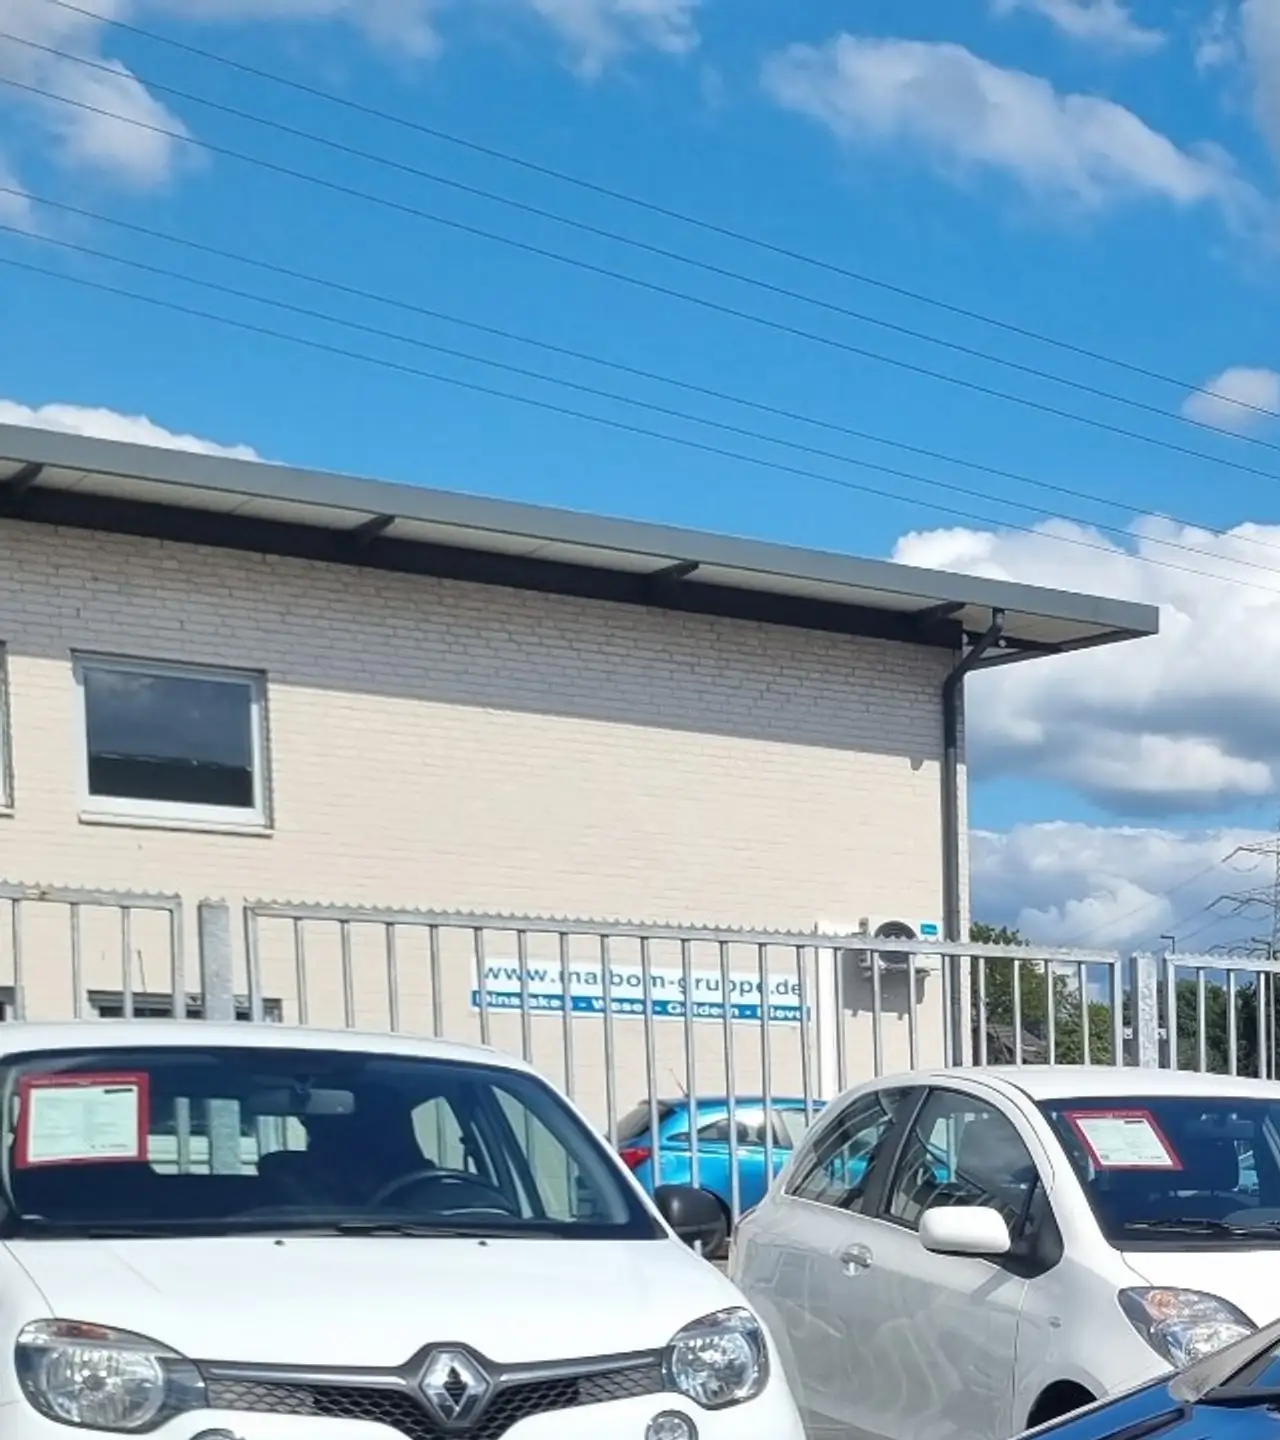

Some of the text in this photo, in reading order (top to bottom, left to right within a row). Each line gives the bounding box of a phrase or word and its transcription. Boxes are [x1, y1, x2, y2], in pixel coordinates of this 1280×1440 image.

[484, 965, 804, 997] www.mabom-grupp.de
[475, 992, 574, 1010] Dinsaken
[591, 998, 650, 1013] Wese
